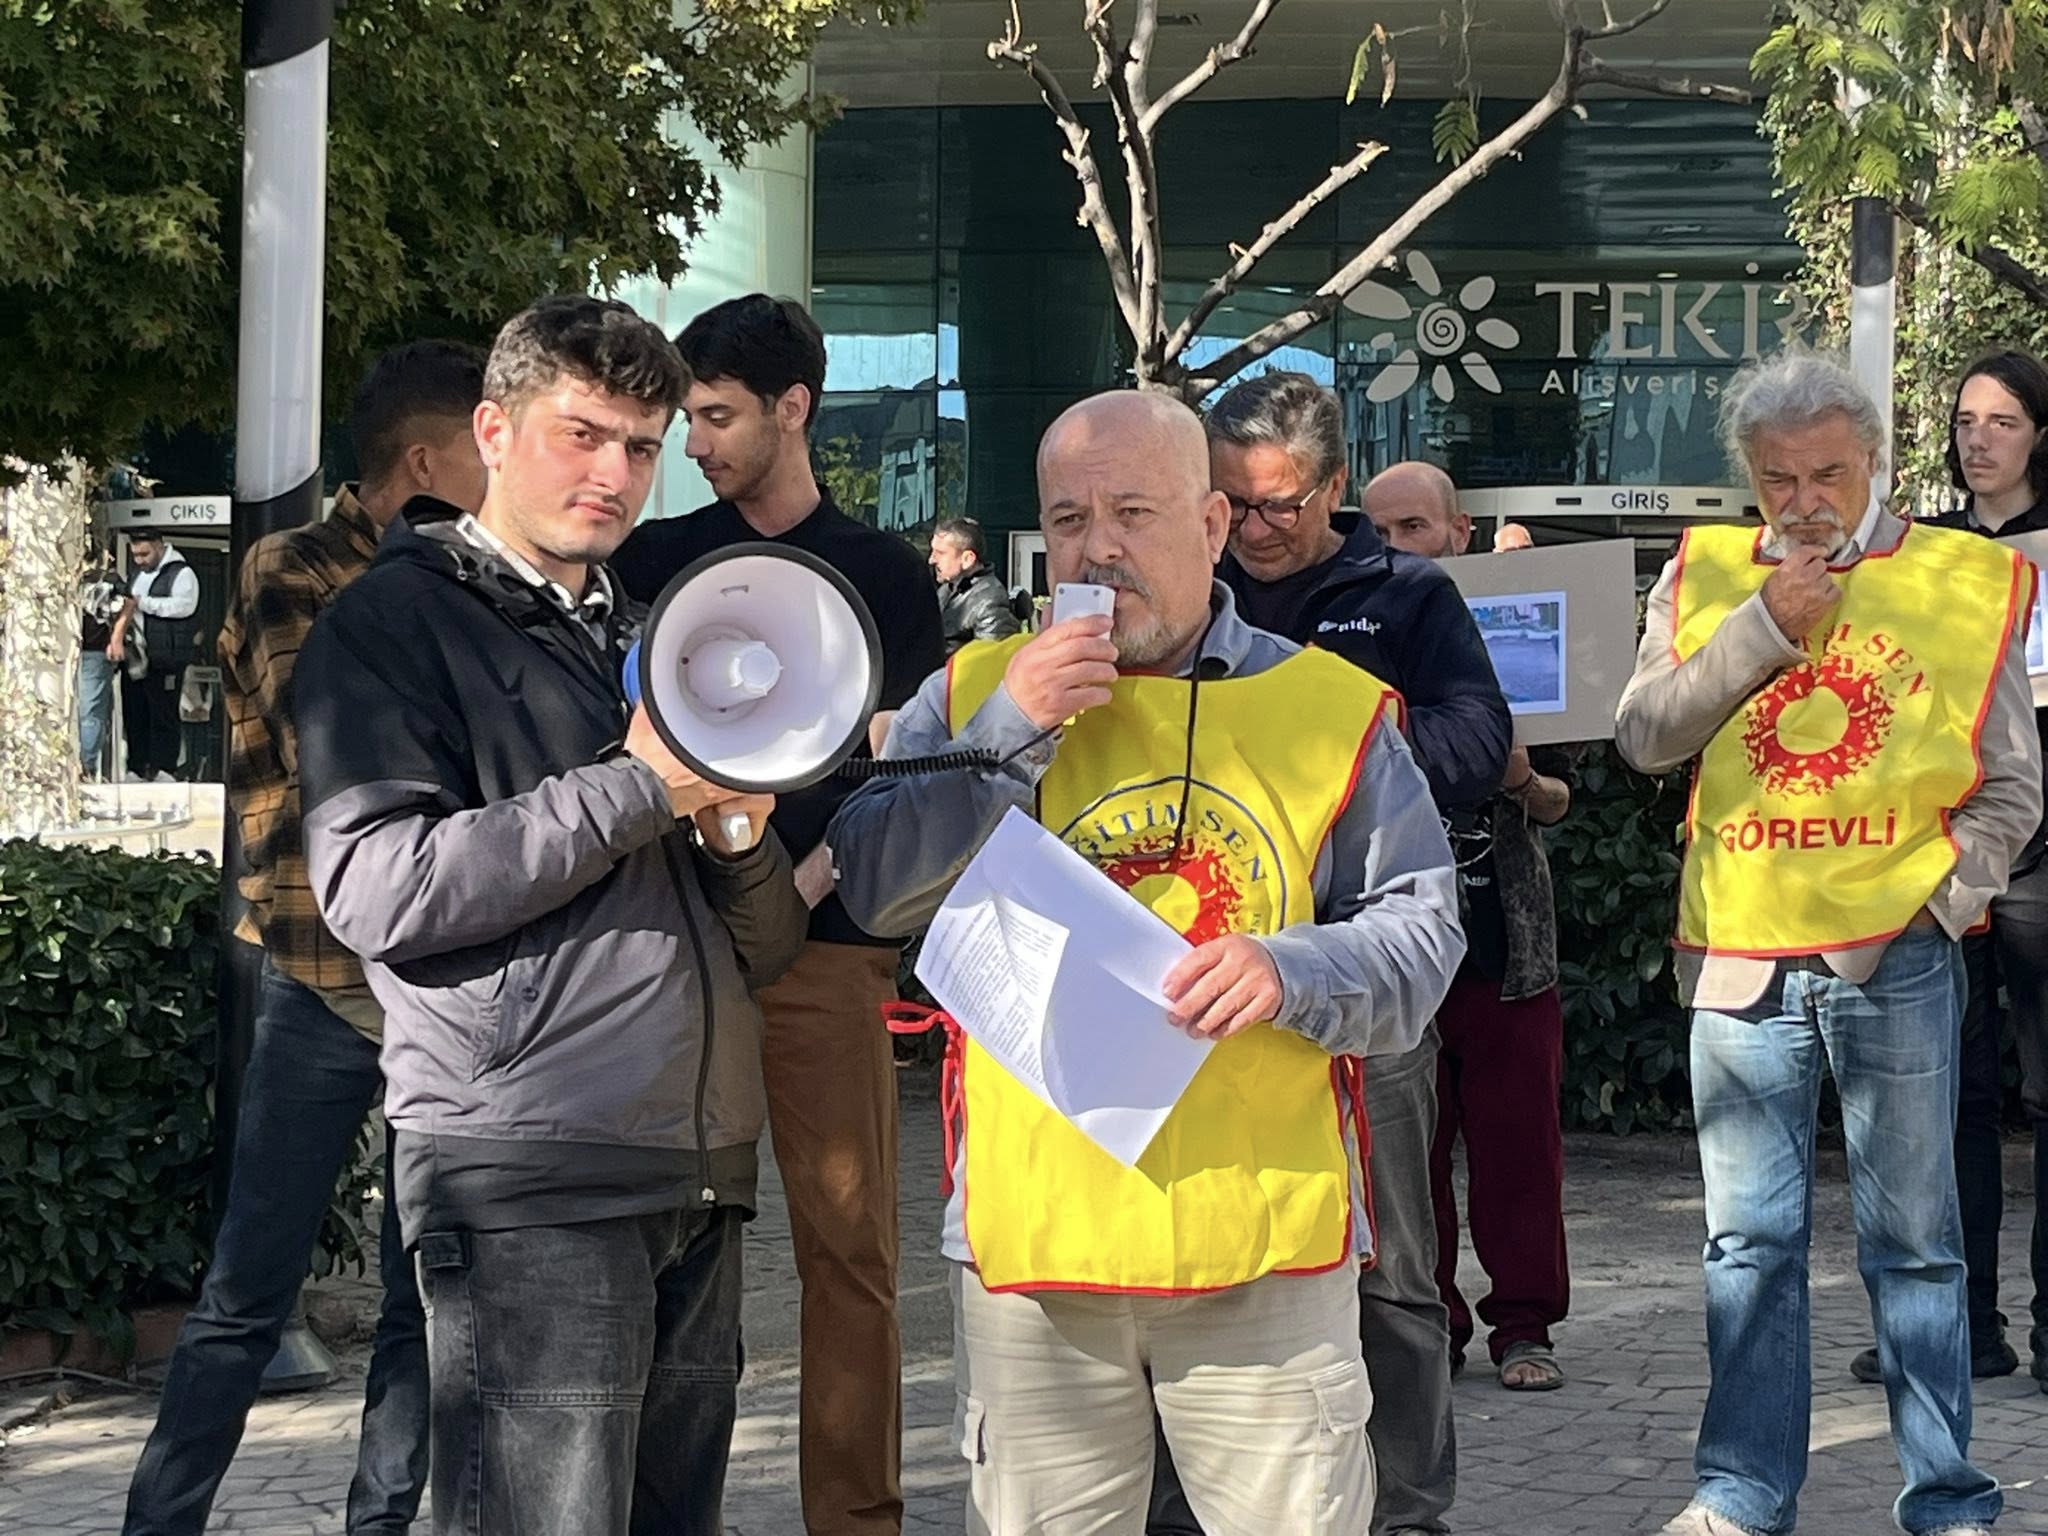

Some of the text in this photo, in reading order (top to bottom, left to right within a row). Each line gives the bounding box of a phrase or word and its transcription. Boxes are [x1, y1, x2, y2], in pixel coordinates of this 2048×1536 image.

[1541, 368, 1720, 399] Alışveriş
[170, 504, 216, 521] ÇIKIŞ
[1611, 489, 1669, 513] GİRİŞ
[1863, 633, 1931, 696] SEN
[1066, 799, 1268, 882] ĞİTİM SEN
[1719, 808, 1895, 853] GÖREVLİ
